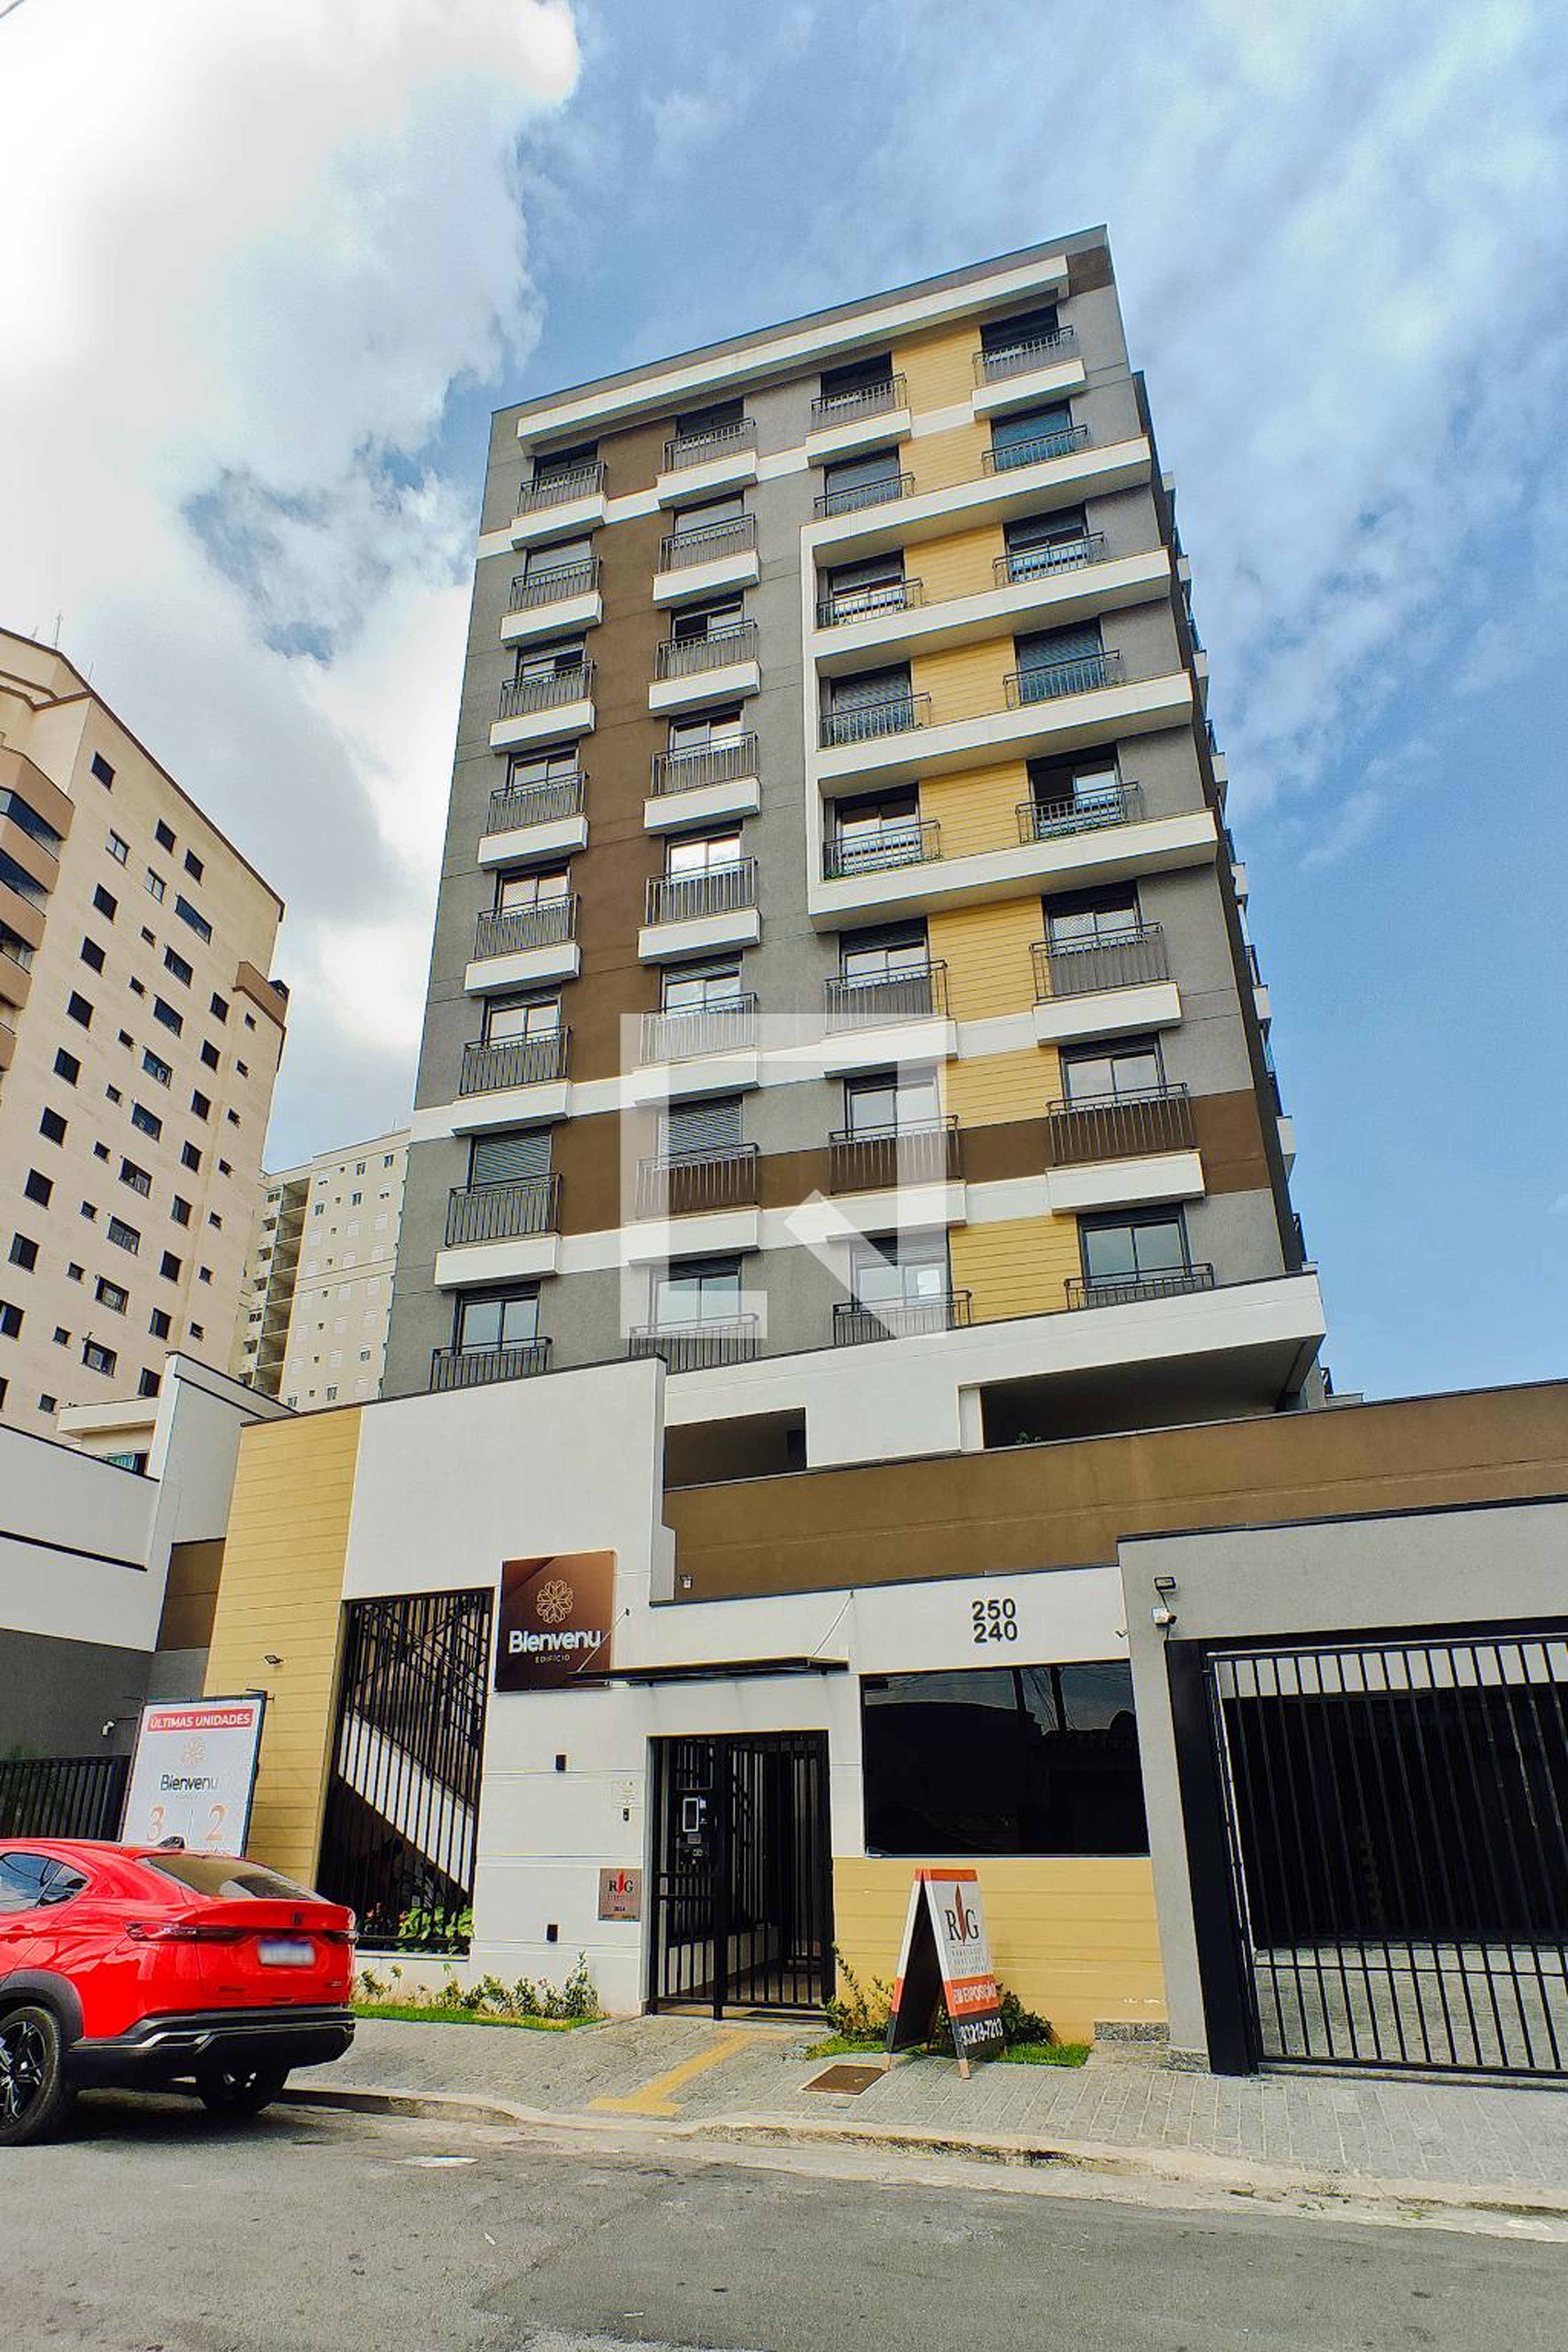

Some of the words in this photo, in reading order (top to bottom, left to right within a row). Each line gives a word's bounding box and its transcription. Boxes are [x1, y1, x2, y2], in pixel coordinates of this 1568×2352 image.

[972, 1598, 1016, 1620] 250
[508, 1630, 601, 1654] Bienvenu
[973, 1620, 1018, 1643] 240
[195, 1713, 250, 1727] UNIDADES
[160, 1774, 220, 1791] Bienvenu
[147, 1806, 165, 1841] 3
[205, 1805, 227, 1841] 2
